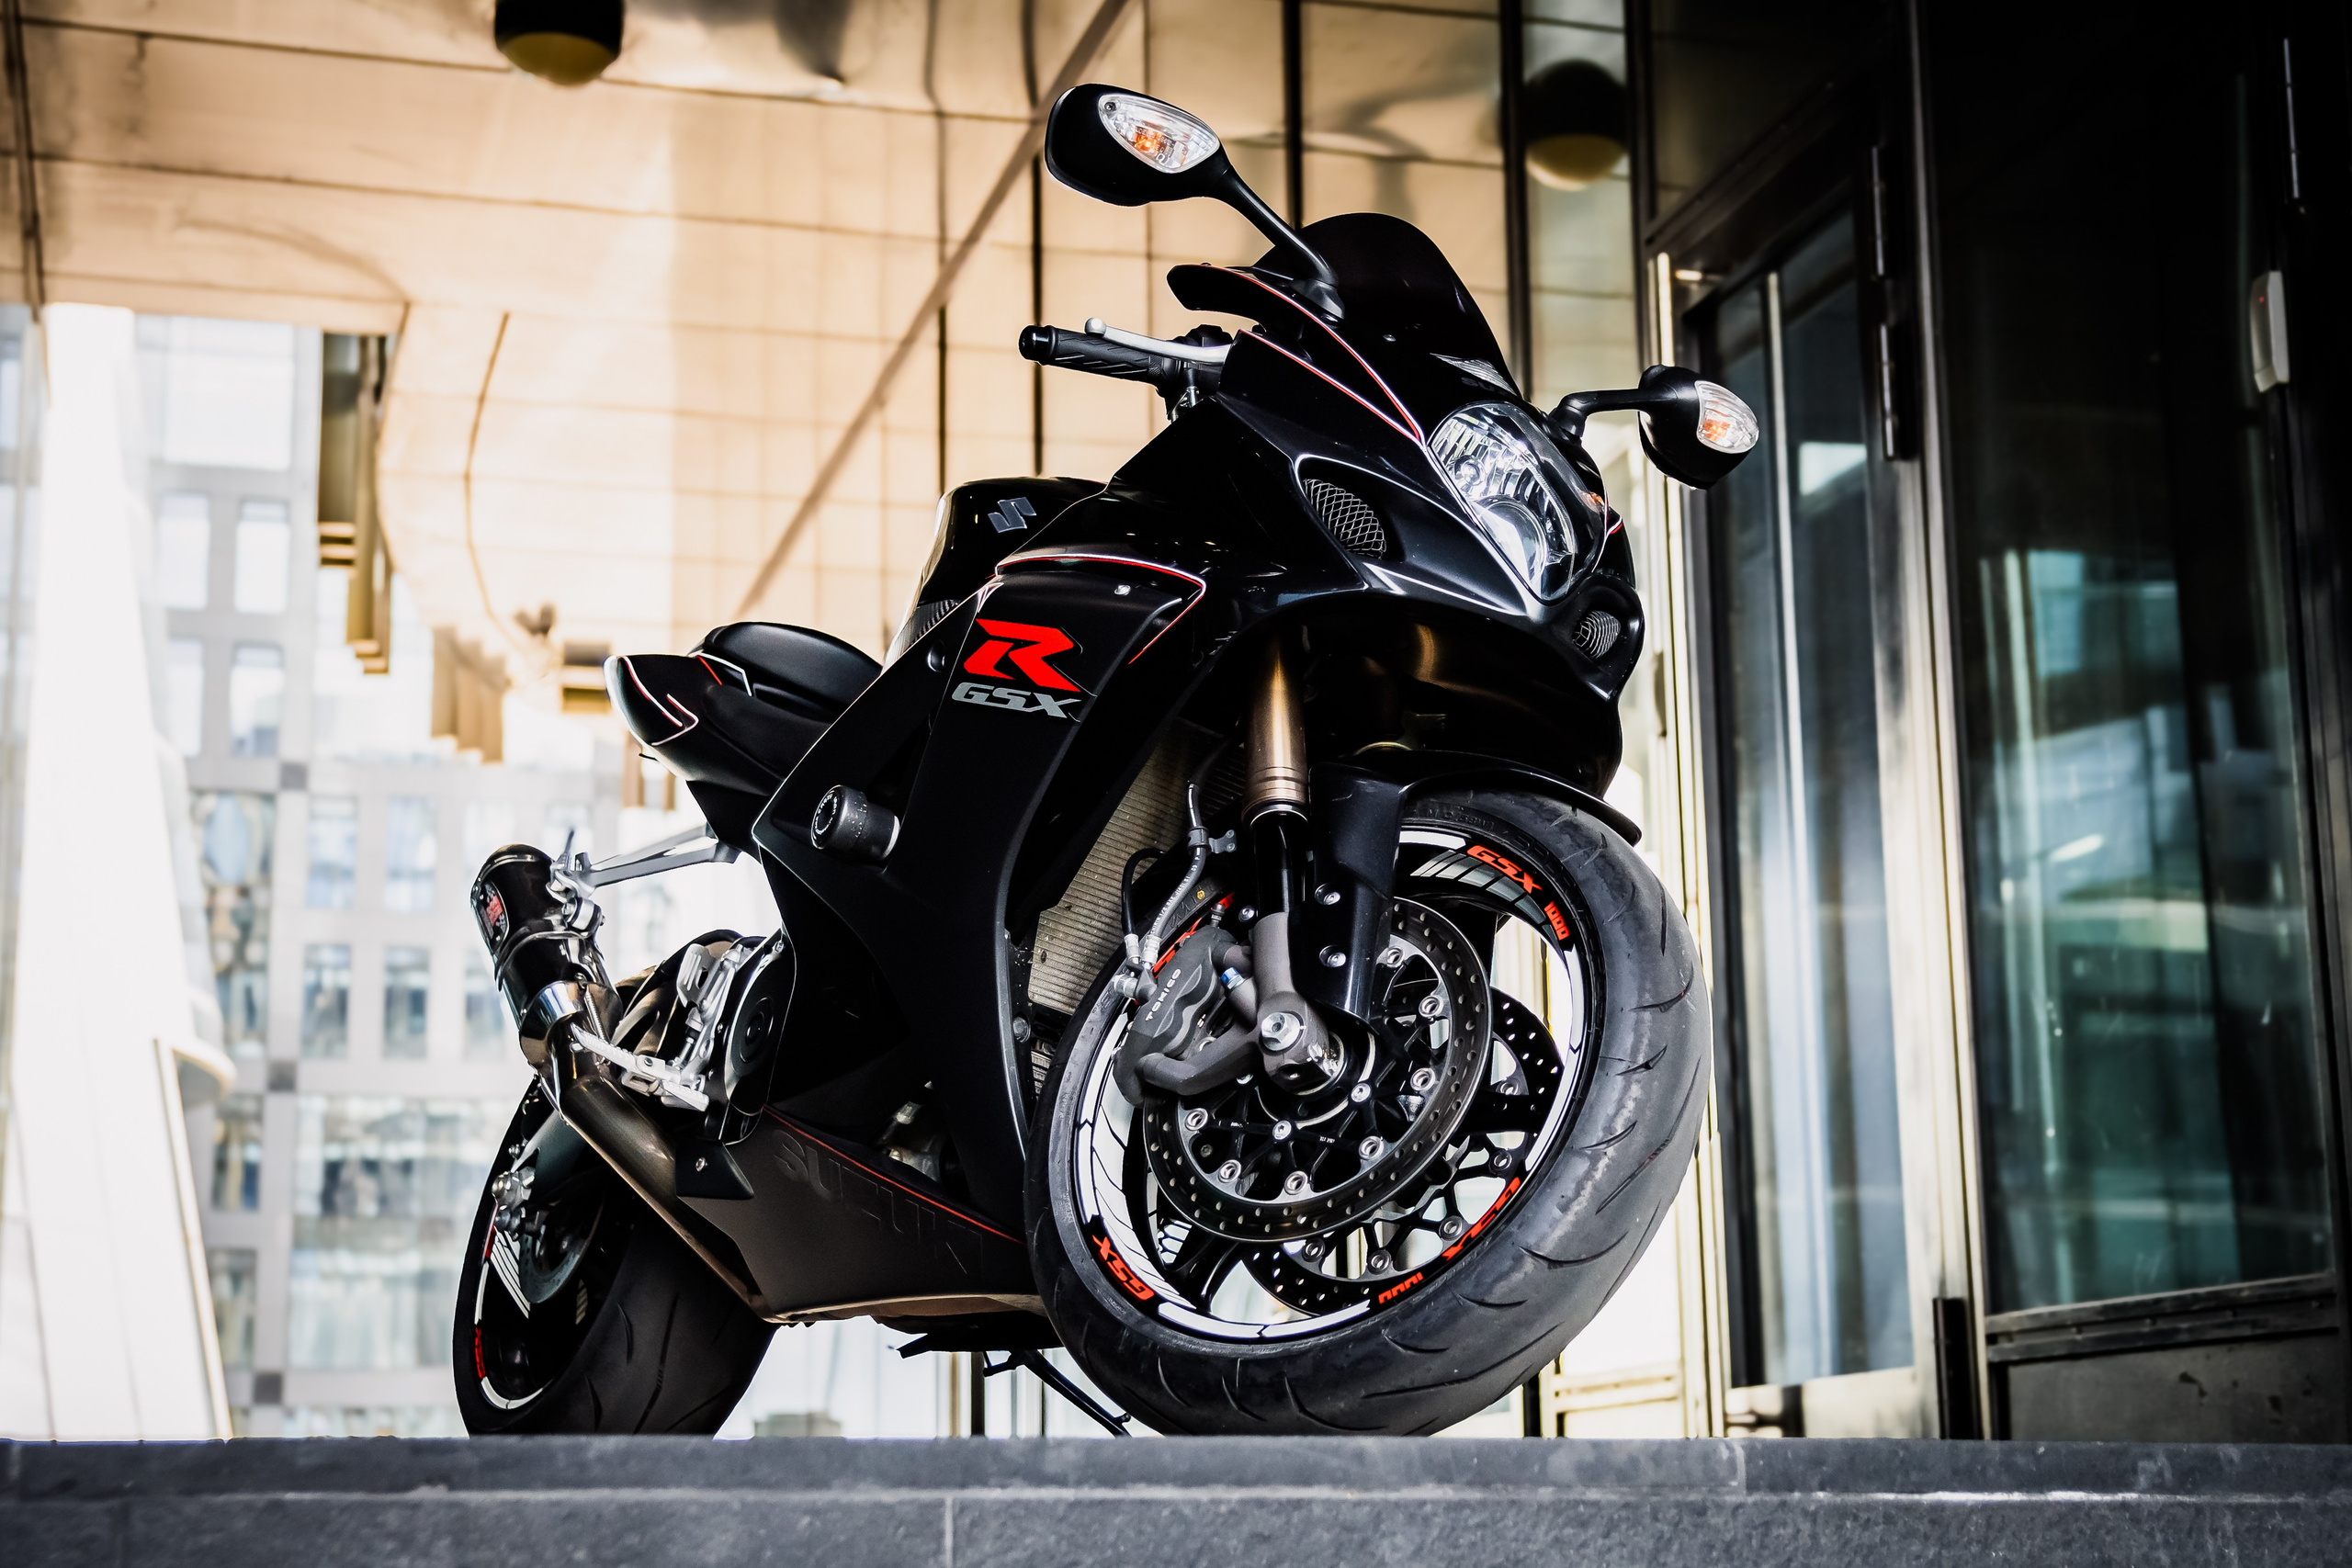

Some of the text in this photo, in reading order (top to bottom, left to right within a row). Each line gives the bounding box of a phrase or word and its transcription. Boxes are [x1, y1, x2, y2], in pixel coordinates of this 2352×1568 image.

[964, 618, 1081, 693] R
[952, 682, 1081, 718] GSX
[1467, 845, 1569, 941] GSX 1000
[1145, 968, 1182, 1021] TOKICO
[1091, 1234, 1155, 1301] GSX
